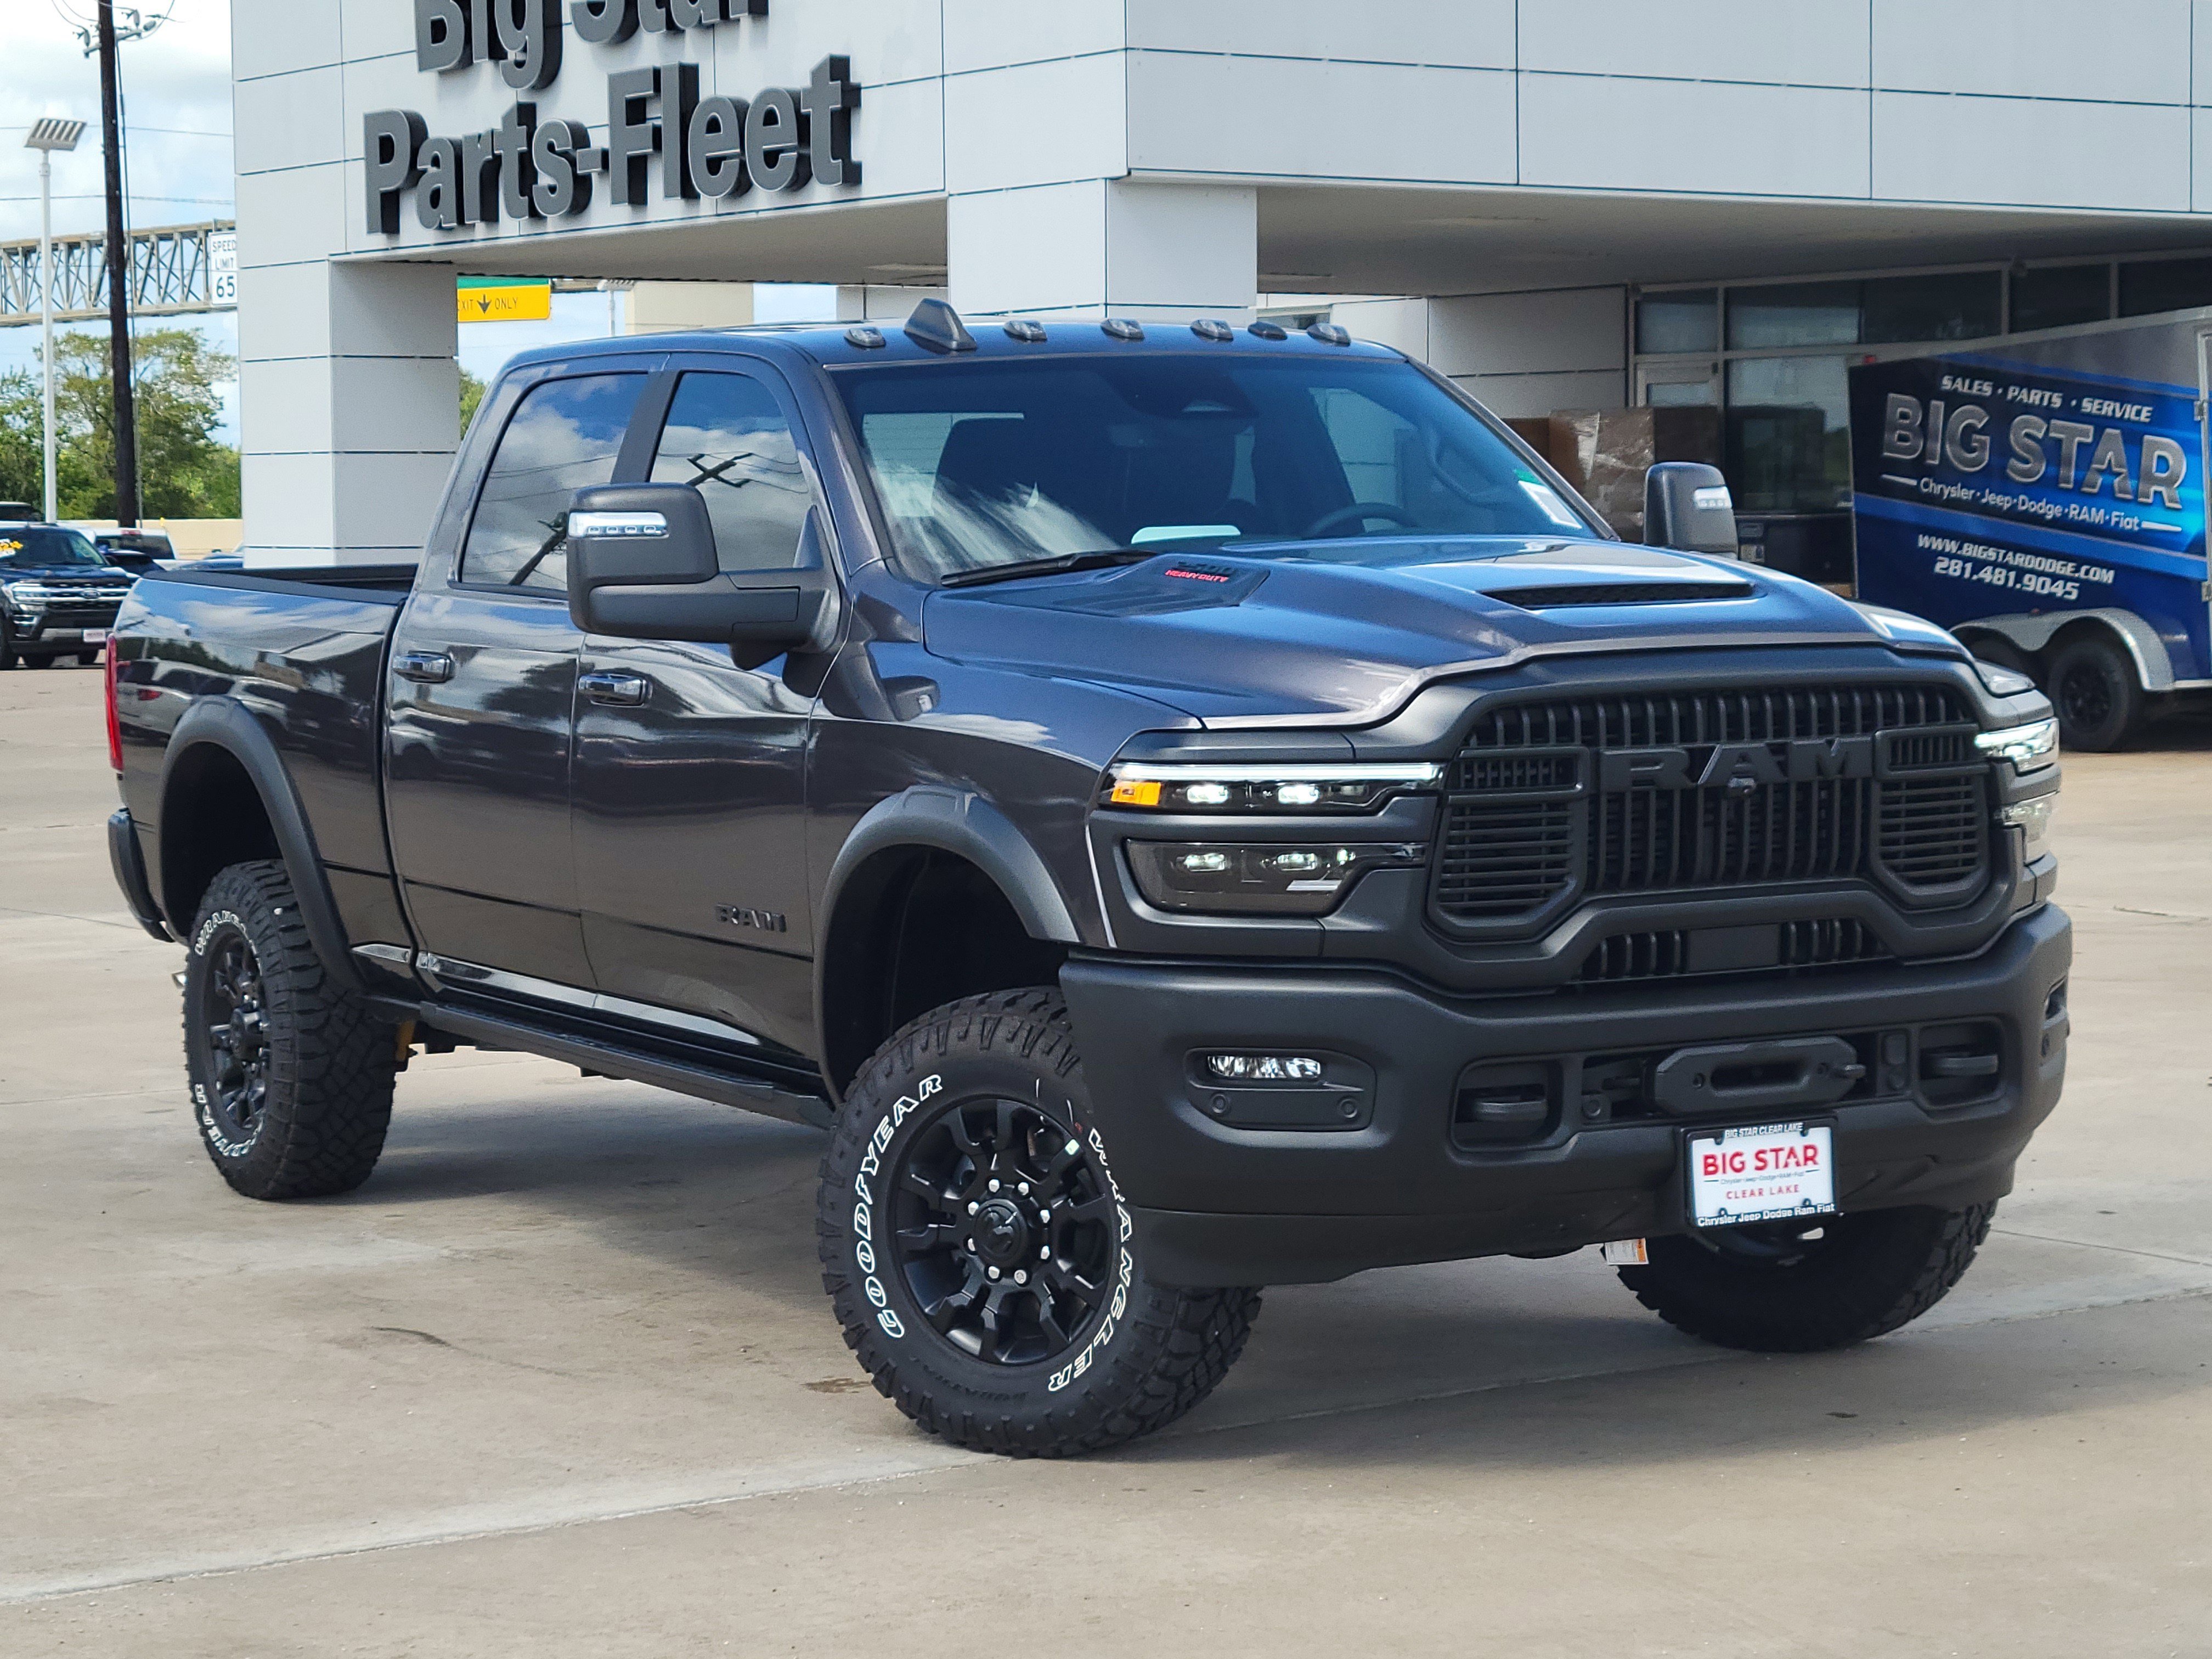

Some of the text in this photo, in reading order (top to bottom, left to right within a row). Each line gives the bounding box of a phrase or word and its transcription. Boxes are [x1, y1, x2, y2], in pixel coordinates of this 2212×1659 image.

[363, 54, 862, 234] Parts-Fleet
[212, 240, 236, 252] SPEED
[215, 257, 234, 270] LIMIT
[216, 276, 235, 297] 65
[458, 297, 518, 312] XIT ONLY
[1942, 375, 2153, 423] SALES PARTS SERVICE
[1882, 393, 2188, 509] BIG STAR
[1920, 477, 2140, 531] Chrysler Jeep Dodge RAM Fiat
[1917, 534, 2115, 584] WWW.BIGSTARDODGE.COM
[1165, 569, 1230, 583] HEAVY DUTY
[1934, 556, 2080, 600] 281.481.9045
[1600, 736, 1873, 790] RAM
[715, 903, 787, 933] RAM
[1739, 1127, 1757, 1137] STAR
[1759, 1125, 1783, 1135] CLEAR
[1784, 1122, 1803, 1132] LAKE
[1702, 1144, 1819, 1176] BIG STAR
[854, 1074, 943, 1339] GOODYEAR
[1726, 1184, 1800, 1199] CLEAR LAKE
[1698, 1203, 1835, 1227] Chrysler Jeep Dodge Ram Fiat
[1048, 1127, 1133, 1392] WANGLER
